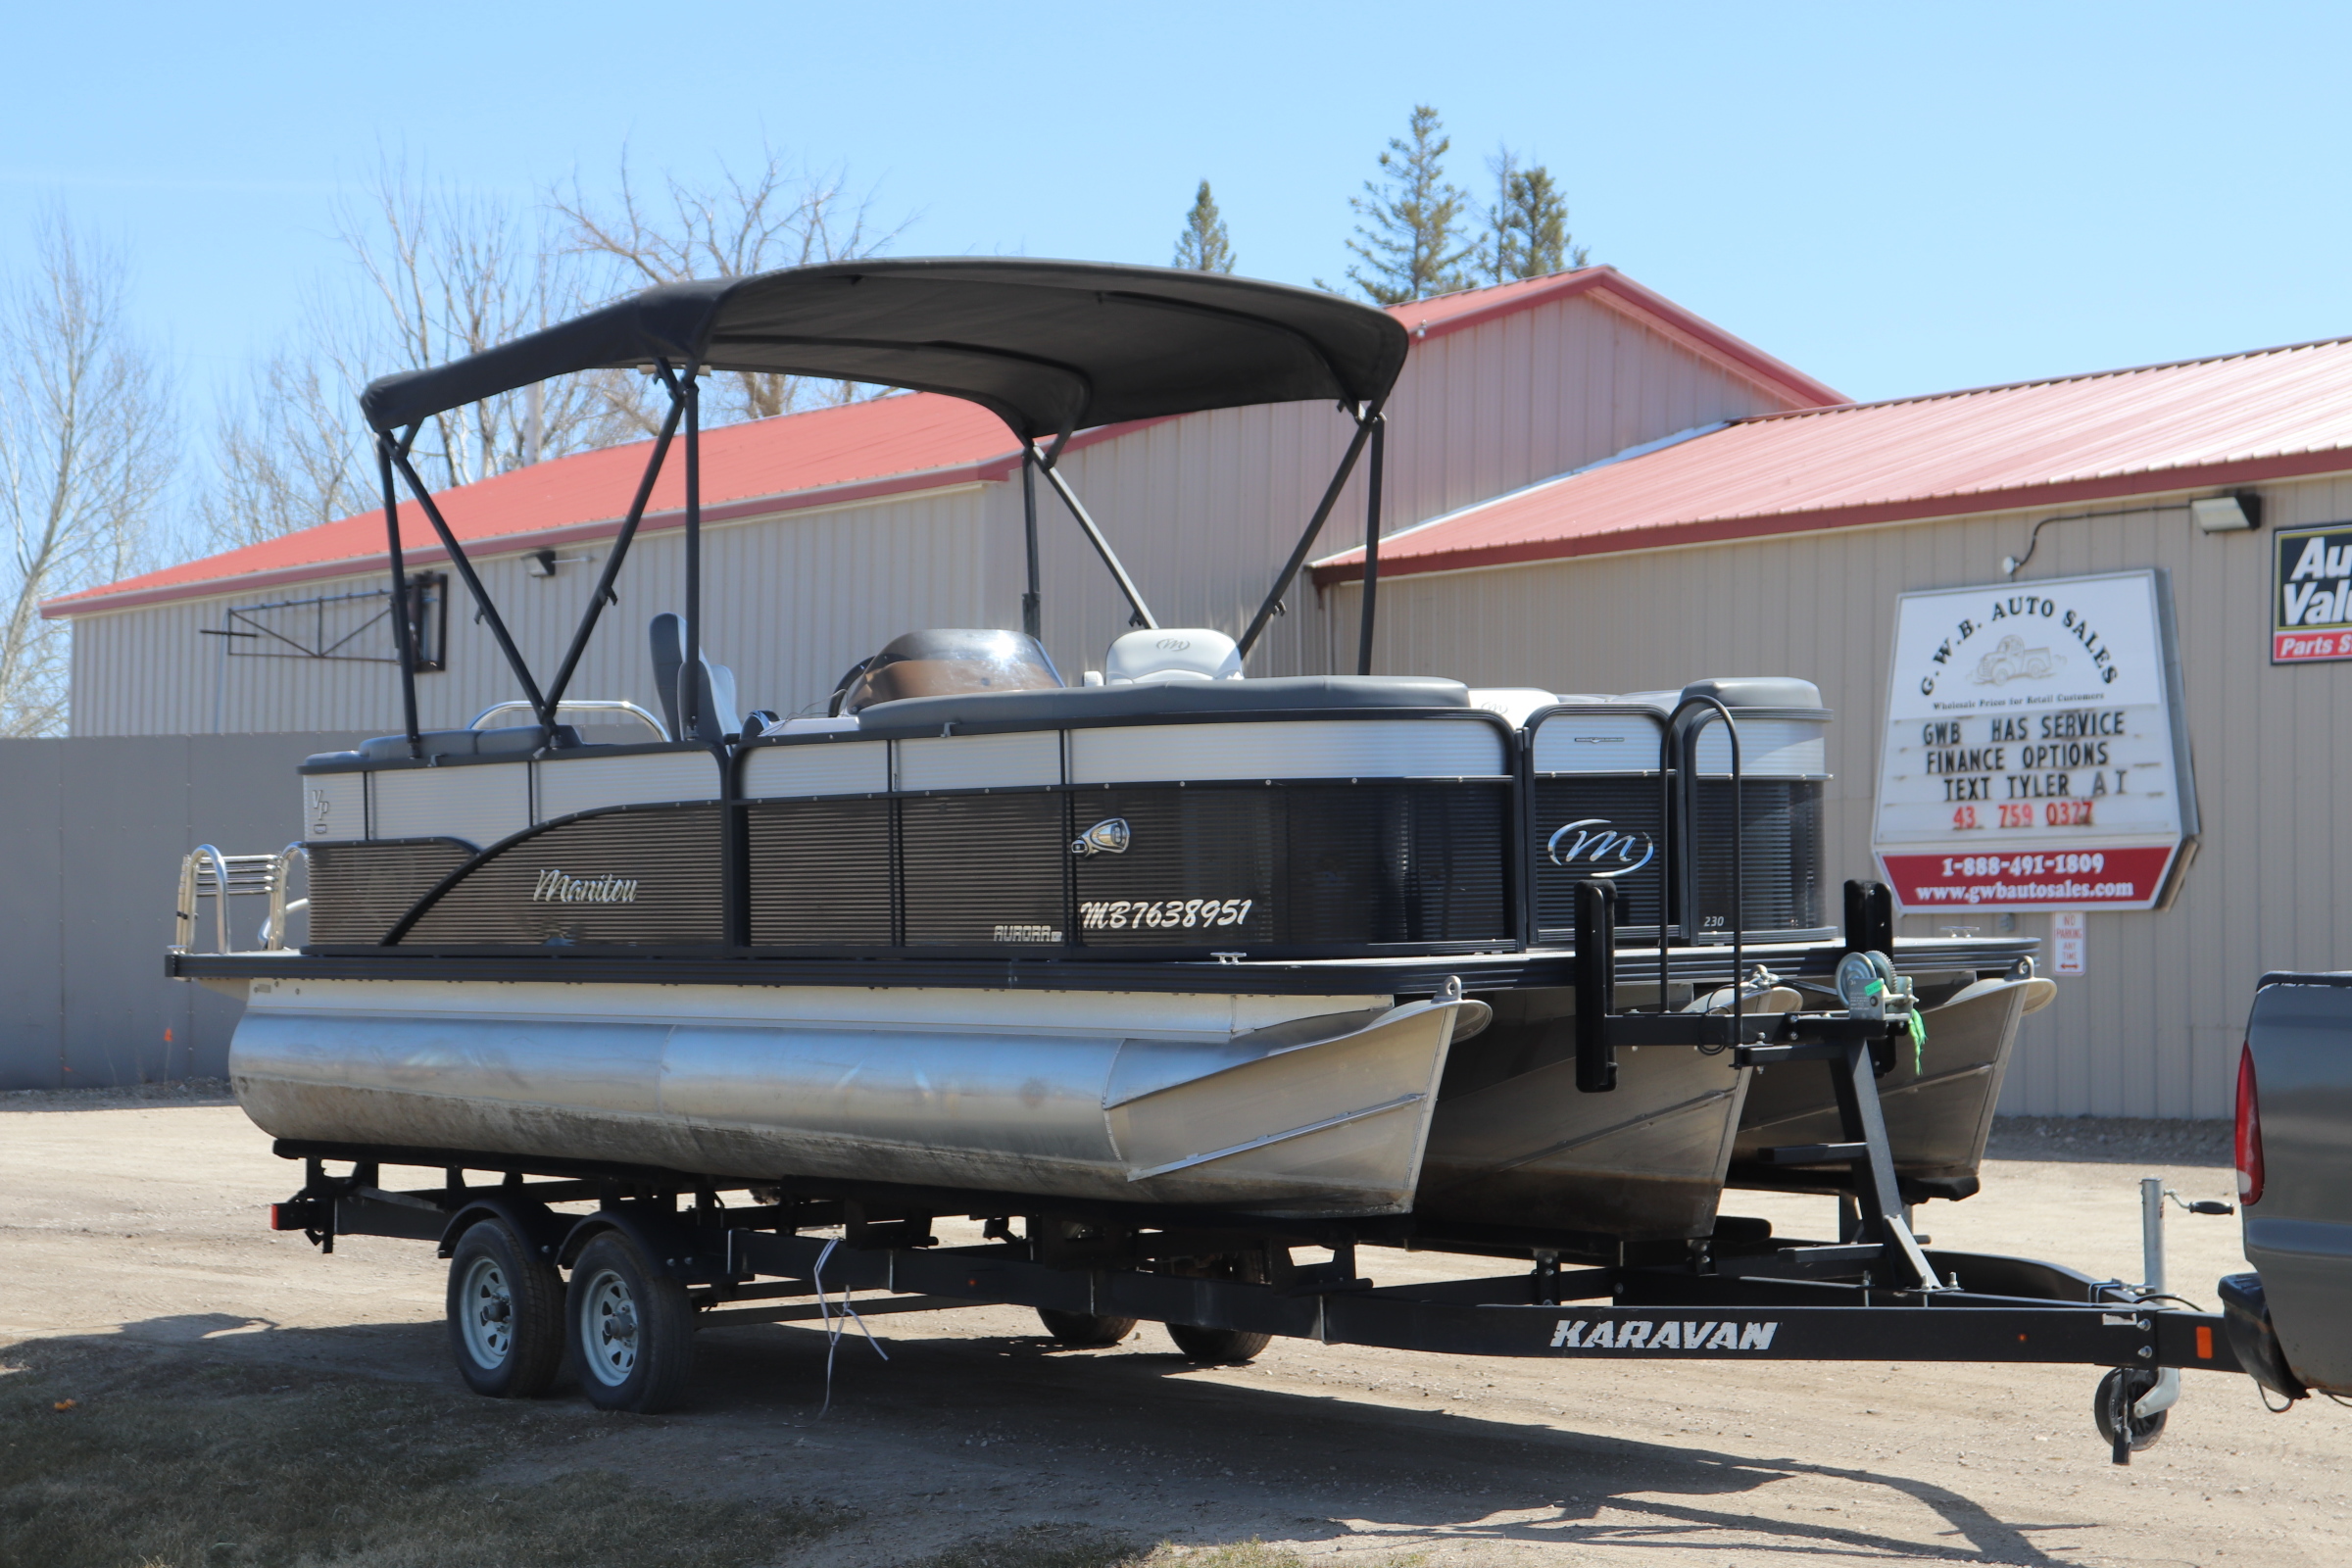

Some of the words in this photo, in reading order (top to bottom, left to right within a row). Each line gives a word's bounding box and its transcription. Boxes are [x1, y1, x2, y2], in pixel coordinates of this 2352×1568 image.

[2283, 579, 2352, 626] Val
[1991, 596, 2055, 621] AUTO
[2062, 609, 2119, 685] SALES
[2280, 636, 2333, 658] Parts
[1934, 700, 1977, 710] Wholesale
[1980, 698, 2006, 708] Prices
[2009, 697, 2024, 706] for
[2027, 695, 2054, 705] Retail
[2057, 692, 2105, 702] Customers
[1923, 721, 1961, 746] GWB
[1991, 716, 2029, 743] HAS
[2041, 710, 2126, 739] SERVICE
[1927, 747, 2005, 774] FINANCE
[2023, 742, 2108, 769] OPTIONS
[1944, 776, 1991, 802] TEXT
[2007, 772, 2070, 800] TYLER
[1998, 804, 2034, 828] 759
[1941, 853, 2105, 877] 1-888-491-1809
[533, 868, 638, 903] Manitou
[1915, 879, 2134, 904] www.gwbautosales.com
[1080, 899, 1252, 929] MB7638951
[1704, 916, 1724, 927] 230
[2064, 914, 2076, 926] NO
[994, 925, 1052, 942] AURORA
[2056, 927, 2082, 940] PARKING
[2063, 942, 2076, 951] ANY
[2063, 951, 2077, 960] TIME
[1550, 1319, 1779, 1350] KARAVAN
